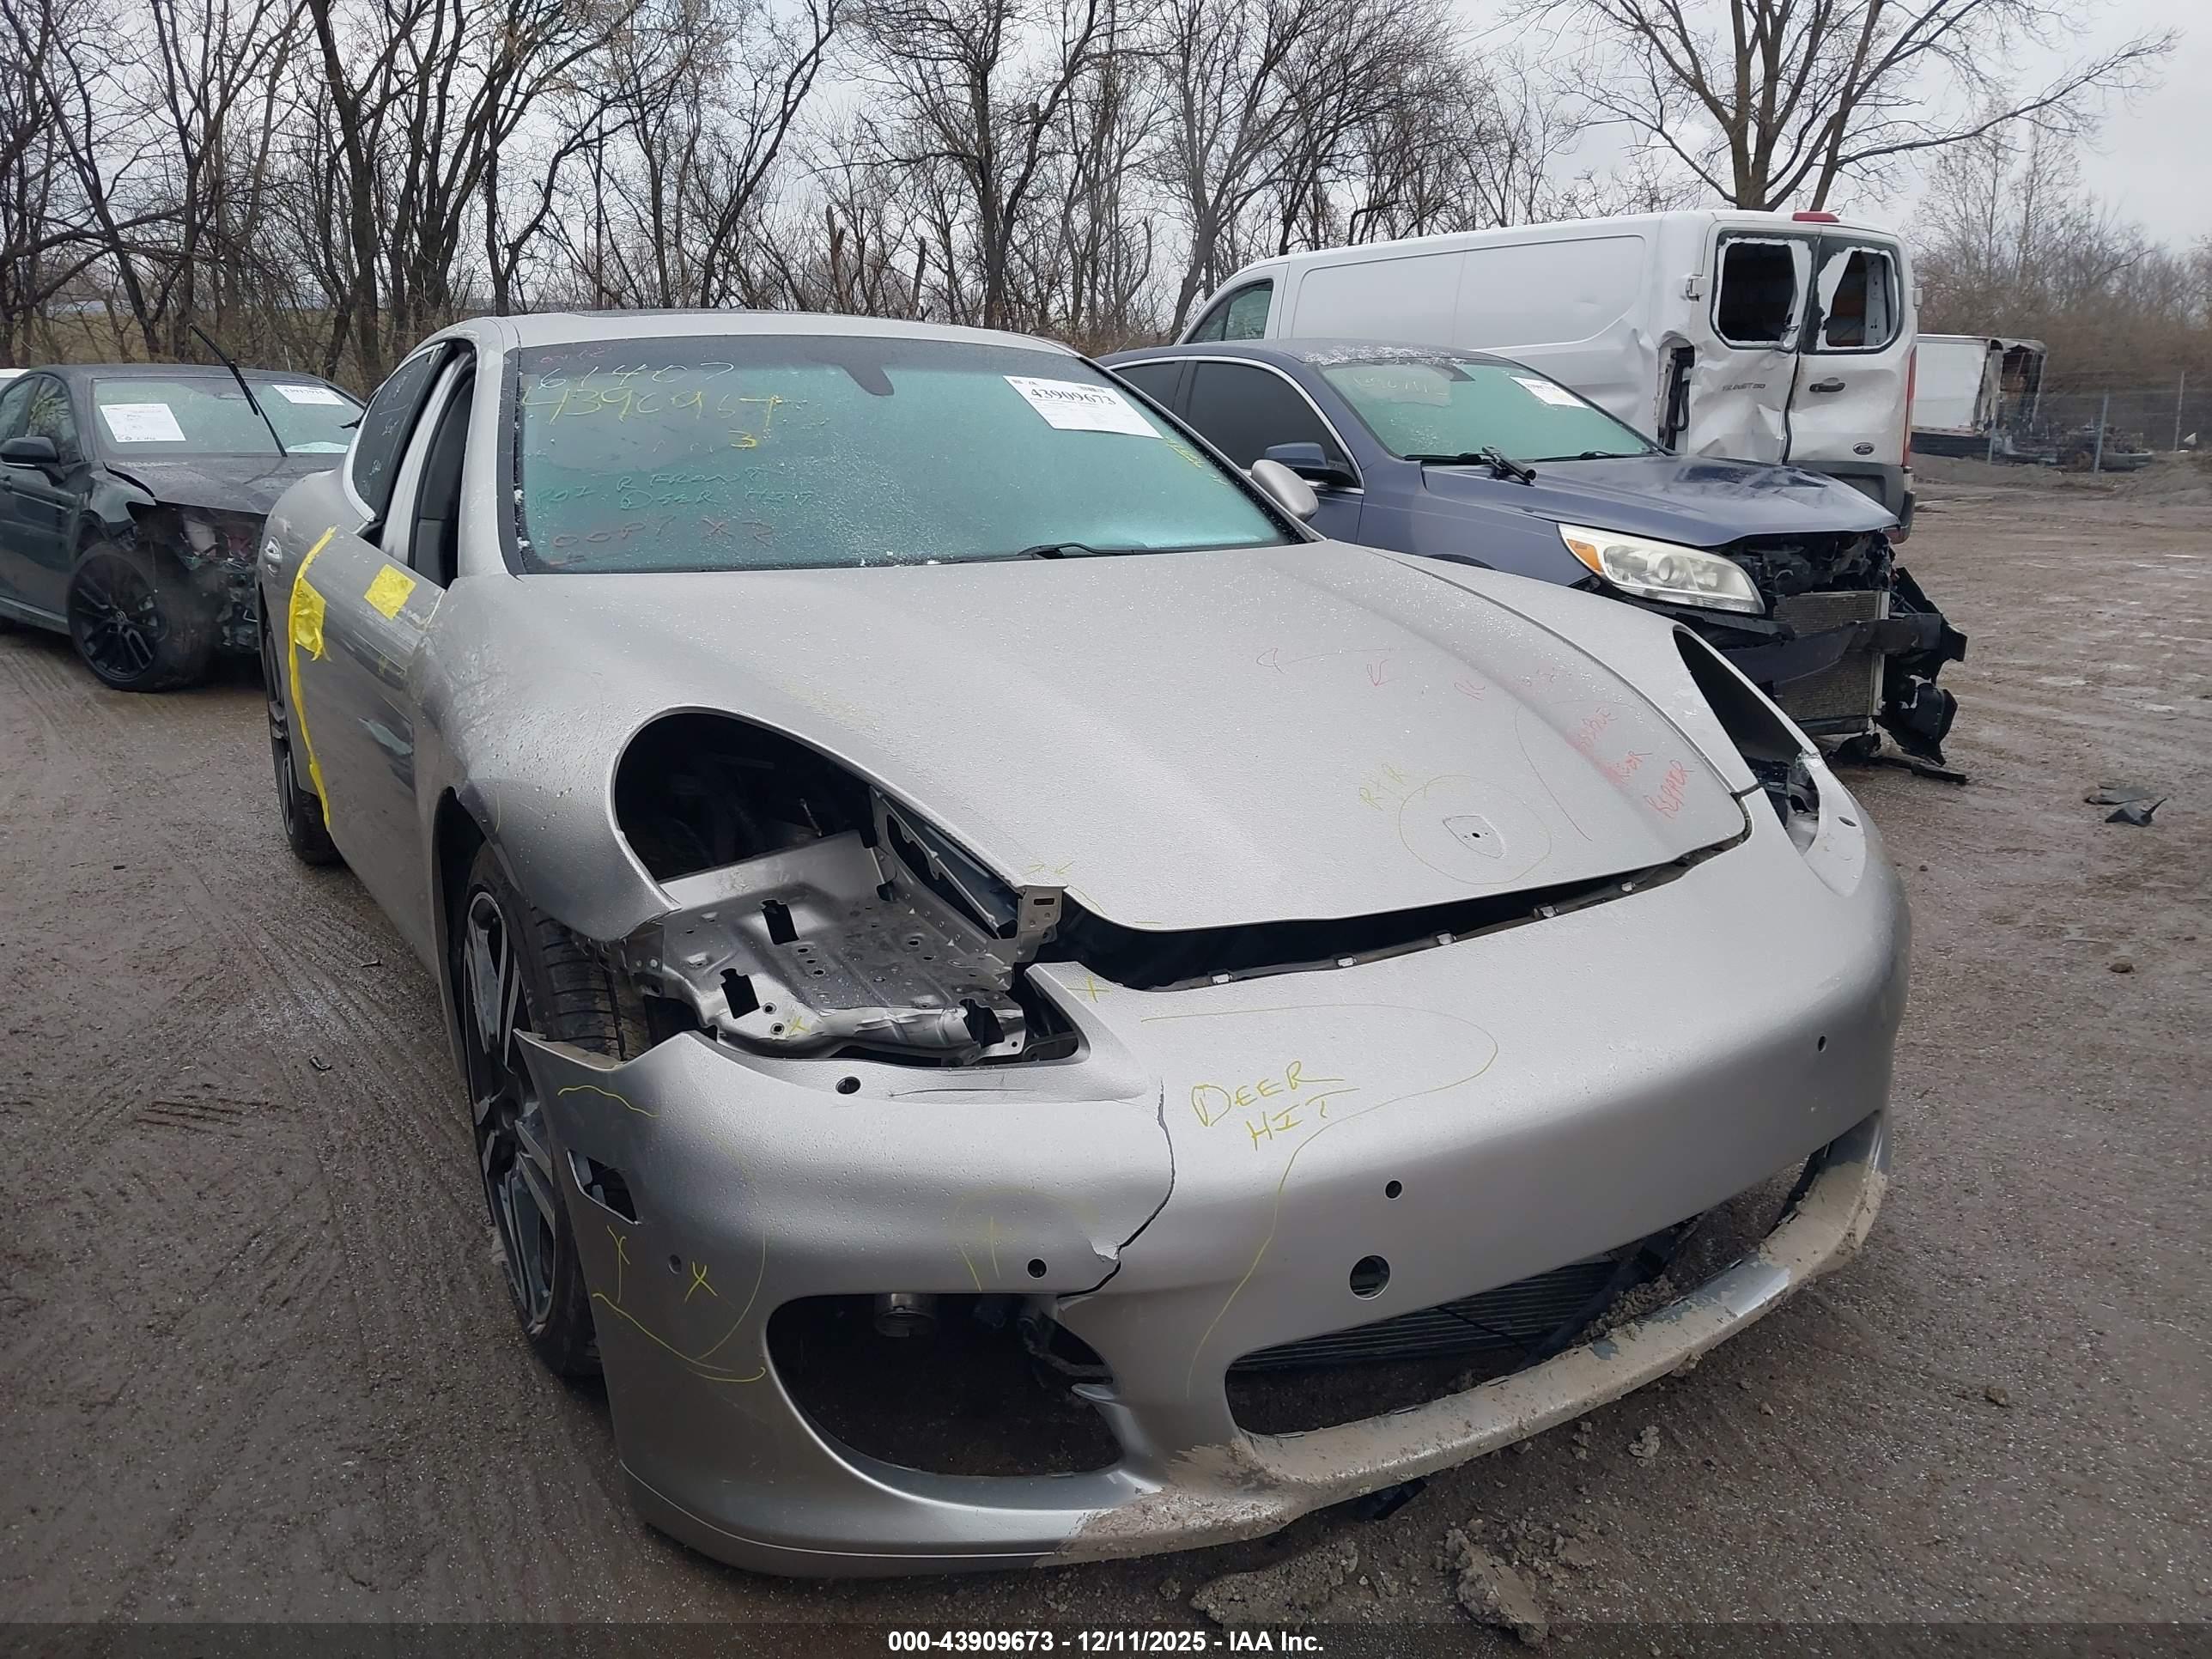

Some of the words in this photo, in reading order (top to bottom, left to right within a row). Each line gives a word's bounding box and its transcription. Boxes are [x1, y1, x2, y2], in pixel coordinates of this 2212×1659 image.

[1030, 388, 1117, 405] 43909673
[1192, 1060, 1345, 1128] DEER
[1246, 1087, 1359, 1152] HIT
